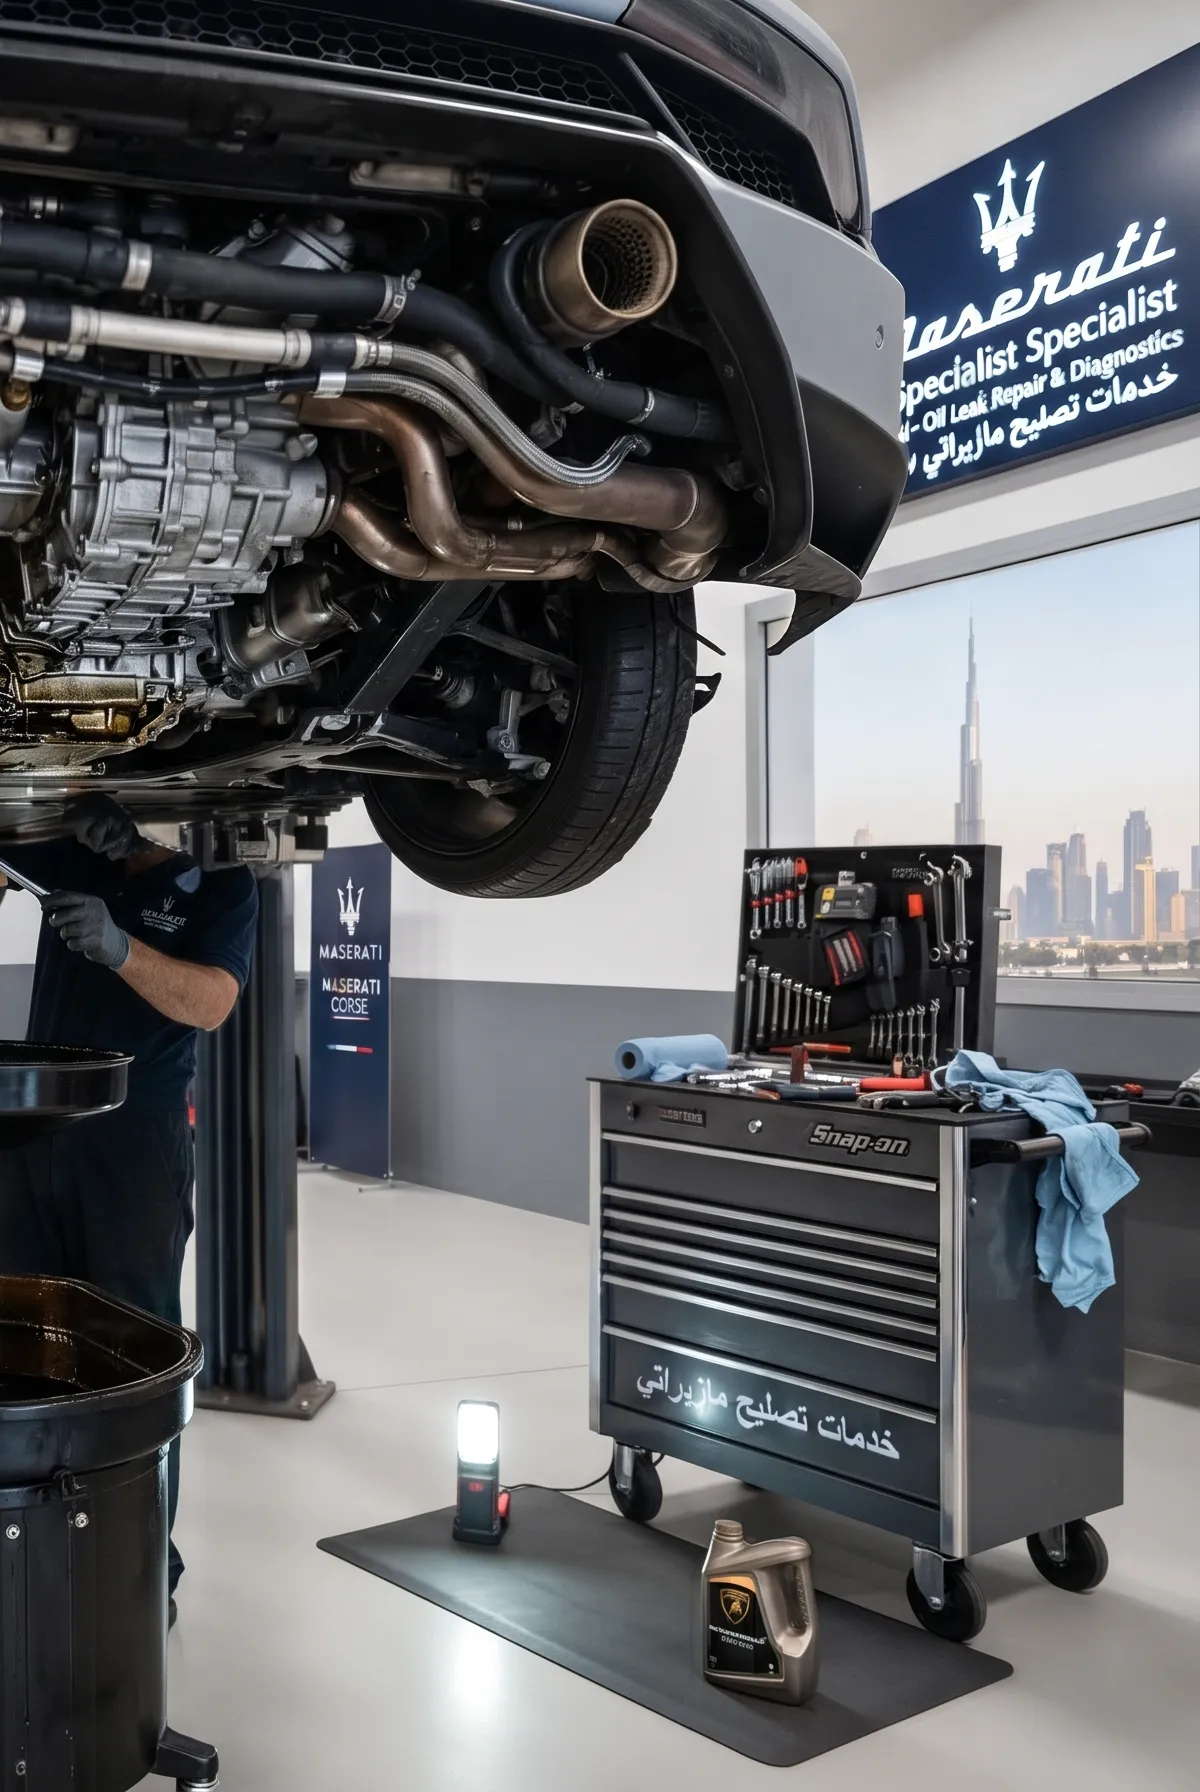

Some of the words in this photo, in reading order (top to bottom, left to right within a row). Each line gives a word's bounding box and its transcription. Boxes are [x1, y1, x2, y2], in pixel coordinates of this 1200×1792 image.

[1026, 278, 1178, 367] Specialist
[922, 404, 947, 432] Oil
[950, 393, 989, 424] Leak
[991, 373, 1047, 411] Repair
[1050, 367, 1066, 388] &
[1070, 329, 1184, 380] Diagnostics
[1085, 362, 1179, 413] خدمات
[1009, 393, 1080, 448] تصليح
[319, 944, 382, 960] MASERATI
[322, 977, 381, 995] MASERATI
[331, 997, 369, 1014] CORSE
[810, 1124, 908, 1155] Snap-on
[637, 1364, 729, 1408] مازيراتي
[736, 1392, 808, 1431] تصليح
[817, 1415, 900, 1460] خدمات
